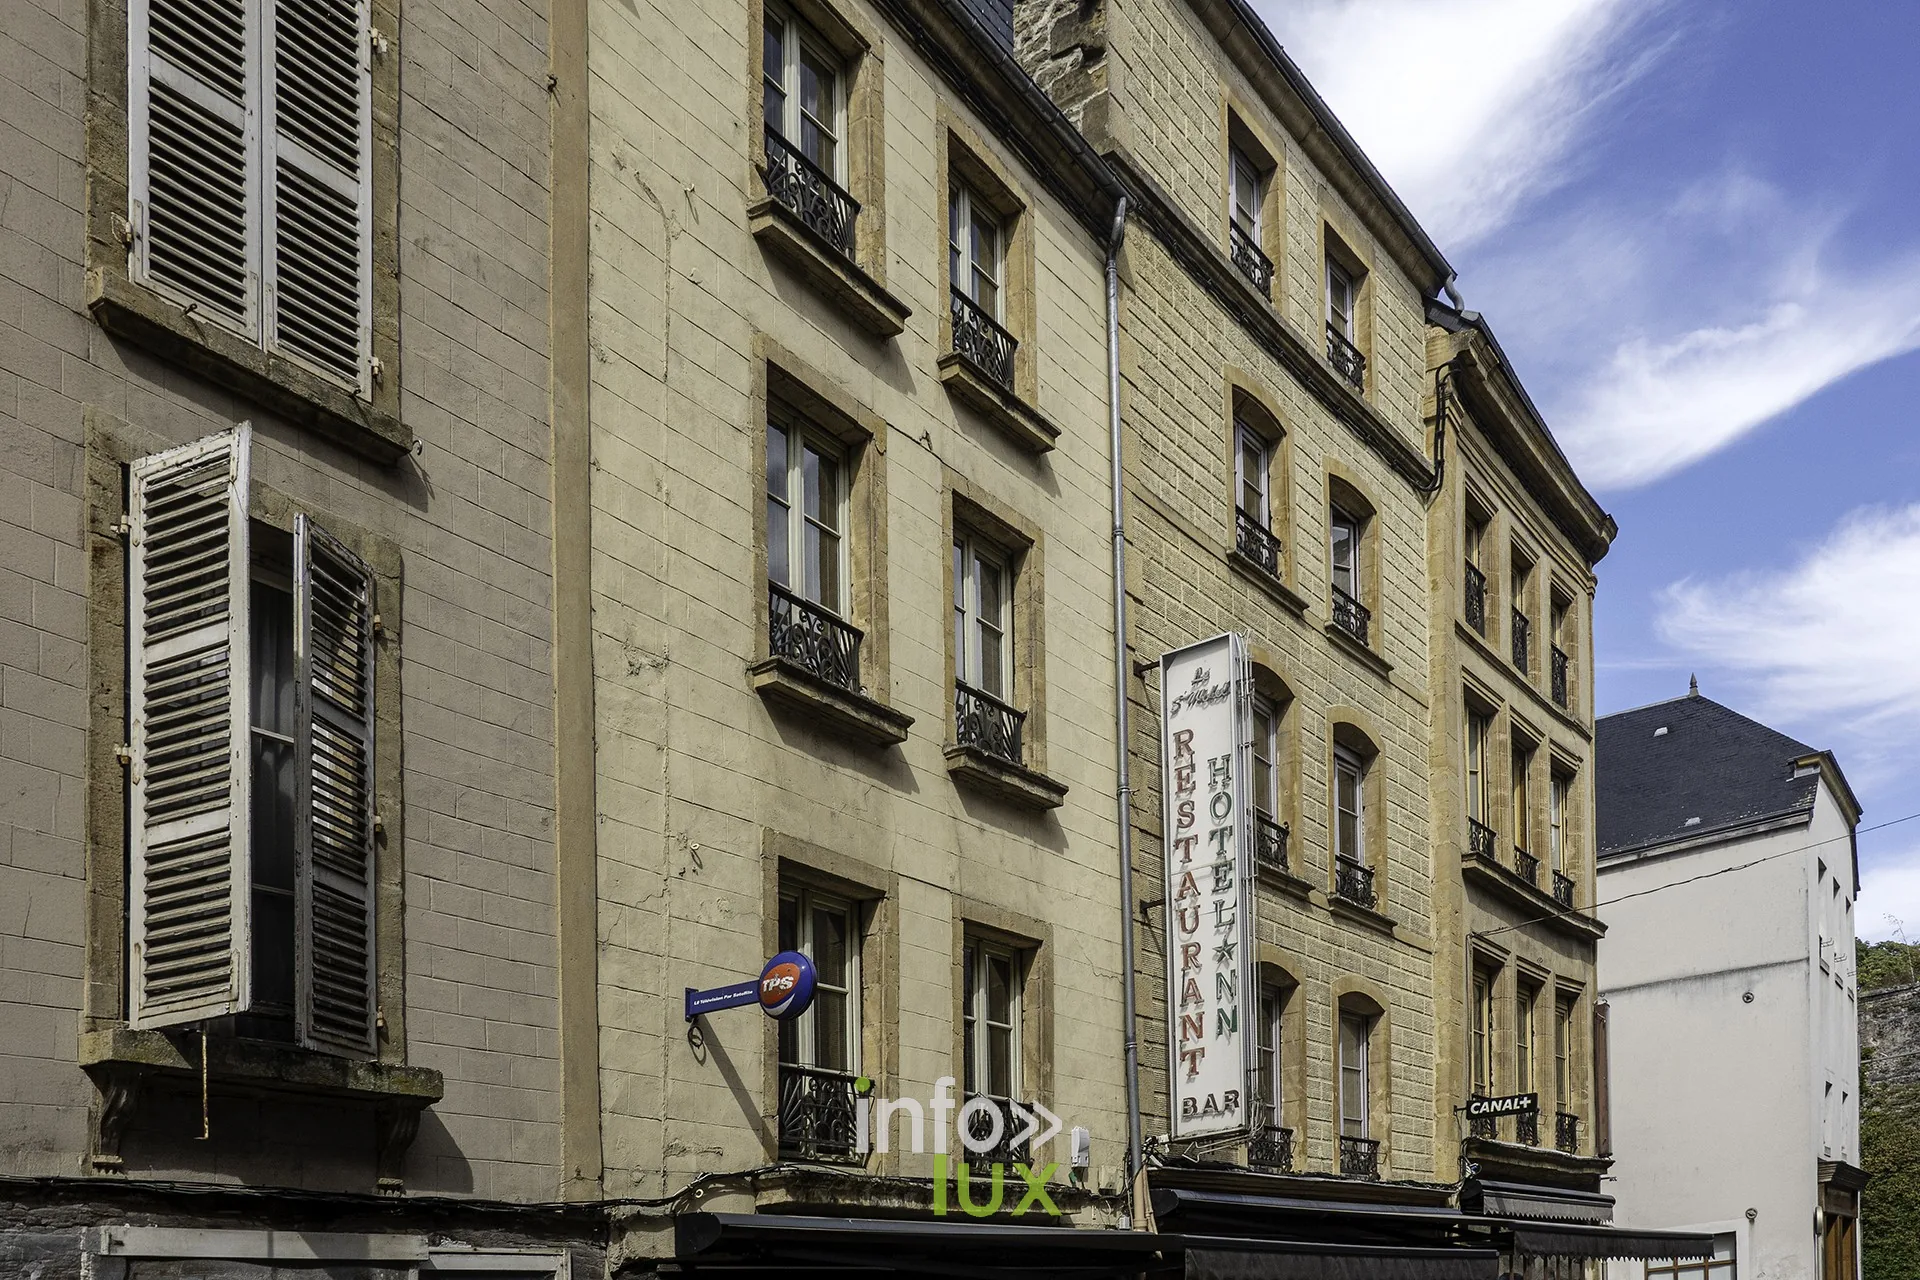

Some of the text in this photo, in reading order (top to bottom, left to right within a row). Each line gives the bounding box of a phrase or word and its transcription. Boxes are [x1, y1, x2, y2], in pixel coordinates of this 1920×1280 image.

[1173, 728, 1206, 1077] RESTAURANT
[1207, 753, 1238, 1037] HOTEL NN
[762, 975, 794, 993] TPS
[1182, 1089, 1240, 1117] BAR
[1470, 1096, 1531, 1115] CANAL+
